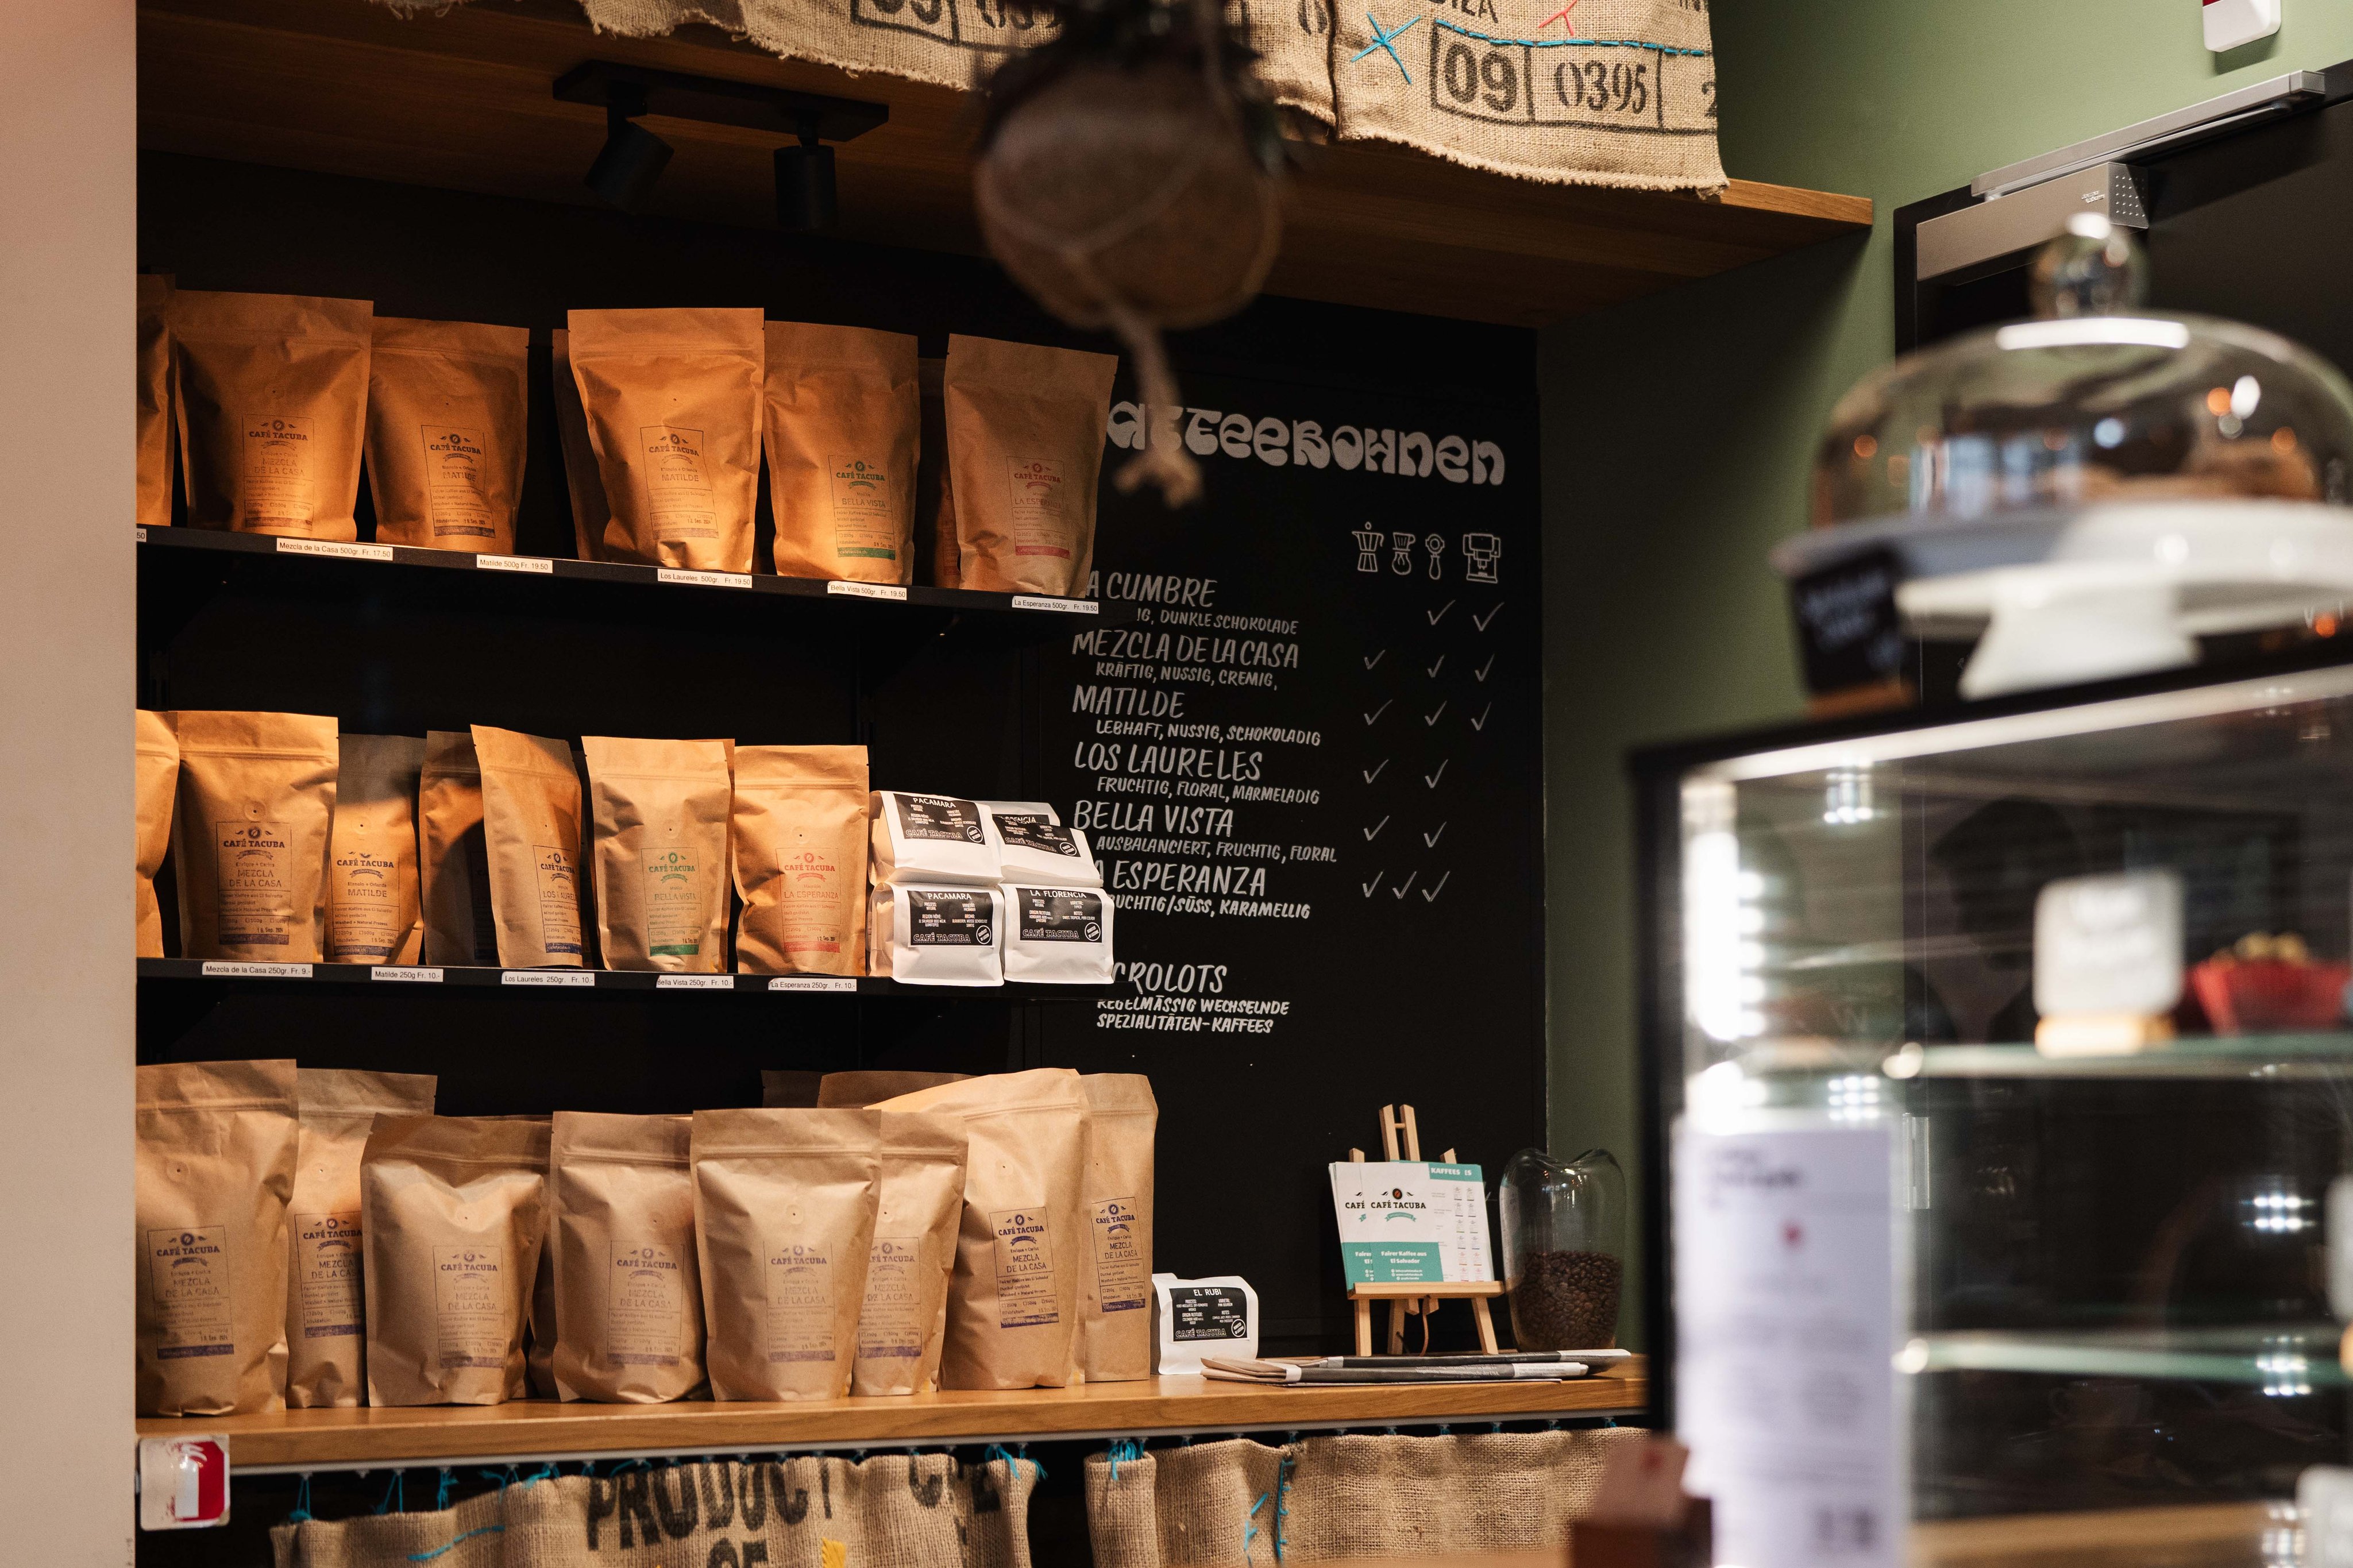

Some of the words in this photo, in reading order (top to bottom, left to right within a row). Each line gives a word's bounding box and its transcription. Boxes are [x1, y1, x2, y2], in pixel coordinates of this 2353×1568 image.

[1445, 43, 1517, 112] 09
[1555, 60, 1647, 114] 0395
[249, 430, 271, 438] CAFÉ
[273, 432, 308, 441] TACUBA
[649, 444, 670, 453] CAFÉ
[672, 446, 700, 456] TACUBA
[836, 471, 855, 479] CAFÉ
[856, 473, 885, 481] TACUBA
[279, 542, 303, 551] Mezcla
[304, 544, 313, 552] de
[314, 544, 320, 553] la
[322, 545, 339, 554] Casa
[340, 547, 361, 557] 500gr.
[373, 549, 391, 558] 17.50
[480, 559, 503, 567] Matilde
[504, 561, 519, 570] 500g
[661, 572, 672, 580] Los
[673, 573, 698, 582] Laureles
[701, 575, 720, 584] 500gr.
[735, 577, 751, 585] 19.50
[831, 584, 846, 592] Bella
[847, 586, 860, 594] Vista
[861, 588, 877, 597] 500gr.
[1086, 570, 1100, 598] A
[1106, 572, 1218, 608] CUMBRE
[1023, 600, 1051, 609] Esperanza
[1052, 601, 1069, 611] 500gr.
[1160, 609, 1212, 627] DUNKLE
[1213, 614, 1299, 635] SCHOKOLADE
[1072, 629, 1170, 662] MEZCLA
[1176, 635, 1209, 663] DE
[1212, 638, 1237, 664] LA
[1240, 640, 1299, 669] CASA
[1160, 666, 1215, 686] NUSSIG,
[1218, 669, 1277, 691] CREMIG,
[1072, 685, 1185, 719] MATILDE
[1096, 719, 1164, 740] LEBHAFT,
[1168, 723, 1224, 743] NUSSIG,
[1226, 725, 1321, 746] SCHOKOLADIG
[1074, 741, 1121, 771] LOS
[1127, 744, 1263, 781] LAURELES
[1097, 777, 1173, 798] FRUCHTIG,
[1176, 781, 1230, 802] FLORAL,
[1232, 785, 1320, 805] MARMELADIG
[913, 797, 956, 808] PACAMARA
[1074, 800, 1154, 832] BELLA
[1165, 805, 1234, 837] VISTA
[906, 828, 928, 836] CAFÉ
[928, 831, 963, 839] TACUBA
[223, 839, 246, 847] CAFÉ
[1096, 836, 1212, 858] AUSBALANCIERT,
[1216, 841, 1287, 864] FRUCHTIG,
[1290, 845, 1337, 863] FLORAL
[337, 858, 358, 866] CAFÉ
[361, 860, 394, 868] TACUBA
[649, 864, 668, 872] CAFÉ
[784, 863, 804, 871] CAFÉ
[238, 870, 273, 878] MEZCLA
[556, 865, 575, 874] TACUBA
[230, 879, 241, 887] DE
[259, 879, 281, 887] CASA
[1113, 860, 1266, 896] ESPERANZA
[348, 889, 387, 898] MATILDE
[654, 893, 678, 901] BELLA
[680, 893, 696, 901] VISTA
[797, 891, 839, 899] ESPERANZA
[1043, 890, 1087, 898] FLORENCIA
[1220, 899, 1311, 919] KARAMELLIG
[913, 932, 935, 942] CAFÉ
[936, 934, 971, 942] TACUBA
[1023, 928, 1044, 937] CAFÉ
[1046, 930, 1079, 939] TACUBA
[206, 965, 230, 974] Mezcla
[268, 967, 290, 976] 250gr.
[400, 971, 415, 980] 250g
[547, 976, 566, 984] 250gr.
[689, 980, 708, 988] 250gr.
[1201, 998, 1290, 1015] WECHSELNDE
[1345, 1200, 1365, 1209] CAFÉ
[1371, 1200, 1392, 1208] CAFÉ
[1096, 1216, 1110, 1224] CAFÉ
[1111, 1215, 1135, 1223] TACUBA
[303, 1230, 326, 1239] CAFÉ
[327, 1230, 362, 1238] TACUBA
[998, 1226, 1016, 1235] CAFÉ
[1017, 1225, 1044, 1234] TACUBA
[1110, 1242, 1132, 1250] MEZCLA
[1013, 1253, 1040, 1262] MEZCLA
[1105, 1252, 1113, 1260] DE
[1124, 1249, 1137, 1257] CASA
[1006, 1265, 1017, 1273] DE
[1019, 1264, 1028, 1272] LA
[1029, 1262, 1047, 1270] CASA
[1175, 1328, 1195, 1337] CAFÉ
[1196, 1328, 1226, 1337] TACUBA
